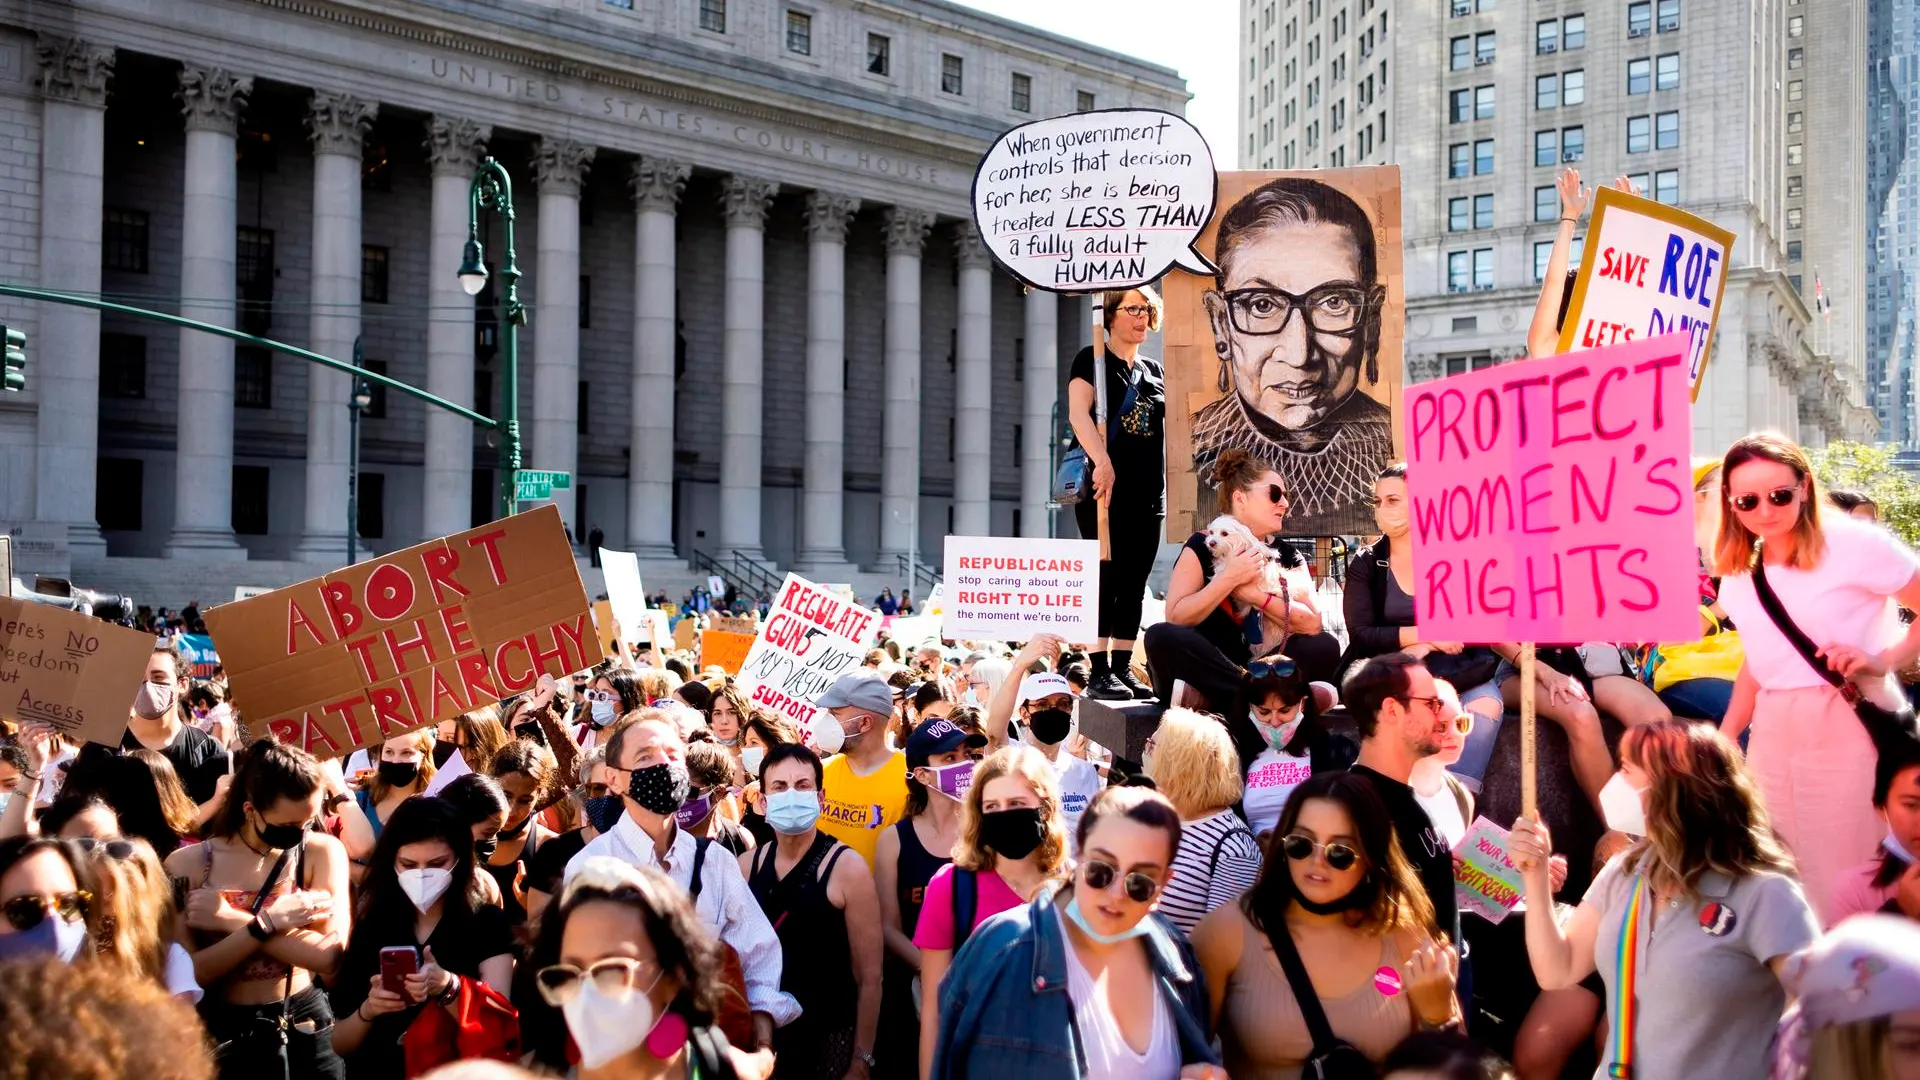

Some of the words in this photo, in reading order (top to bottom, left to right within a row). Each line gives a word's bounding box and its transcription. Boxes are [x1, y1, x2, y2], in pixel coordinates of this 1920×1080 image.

[431, 58, 562, 102] UNITED
[602, 97, 703, 133] STATES
[734, 125, 831, 162] COURT
[856, 150, 938, 183] HOUSE
[1006, 132, 1050, 157] When
[1056, 116, 1170, 155] government
[989, 157, 1063, 183] controls
[1073, 151, 1110, 174] that
[1119, 150, 1191, 168] decision
[983, 192, 1014, 211] for
[1020, 184, 1051, 204] her,
[1062, 180, 1092, 200] she
[1104, 183, 1118, 198] is
[1128, 175, 1180, 203] being
[992, 211, 1054, 235] treated
[1066, 207, 1125, 228] LESS
[1137, 204, 1205, 227] THAN
[1010, 238, 1019, 257] a
[1026, 233, 1073, 262] fully
[1084, 233, 1148, 254] adult
[1055, 258, 1145, 283] HUMAN
[1599, 247, 1649, 288] SAVE
[1658, 233, 1720, 308] ROE
[1582, 318, 1635, 347] LET'S
[1412, 354, 1682, 462] PROTECT
[1414, 443, 1682, 546] WOMEN'S
[959, 557, 1084, 572] REPUBLICANS
[287, 529, 507, 655] ABORT
[958, 576, 981, 586] stop
[988, 576, 1021, 588] caring
[1028, 577, 1058, 587] about
[1425, 544, 1660, 620] RIGHTS
[780, 580, 873, 644] REGULATE
[959, 591, 1012, 605] RIGHT
[1017, 593, 1039, 605] TO
[1045, 594, 1083, 607] LIFE
[957, 609, 973, 619] the
[977, 611, 1020, 621] moment
[1024, 612, 1051, 621] we're
[1055, 611, 1083, 623] born.
[66, 631, 99, 652] NO
[345, 603, 475, 684] THE
[0, 669, 20, 684] ut
[744, 649, 783, 680] MY
[784, 658, 836, 698] VAGIN
[806, 646, 861, 674] NOT
[267, 614, 589, 753] PATRIARCHY
[18, 688, 84, 722] Access
[752, 684, 816, 725] SUPPORT
[1263, 762, 1296, 770] NEVER
[820, 804, 866, 822] MARCH
[1476, 837, 1502, 860] YOUR
